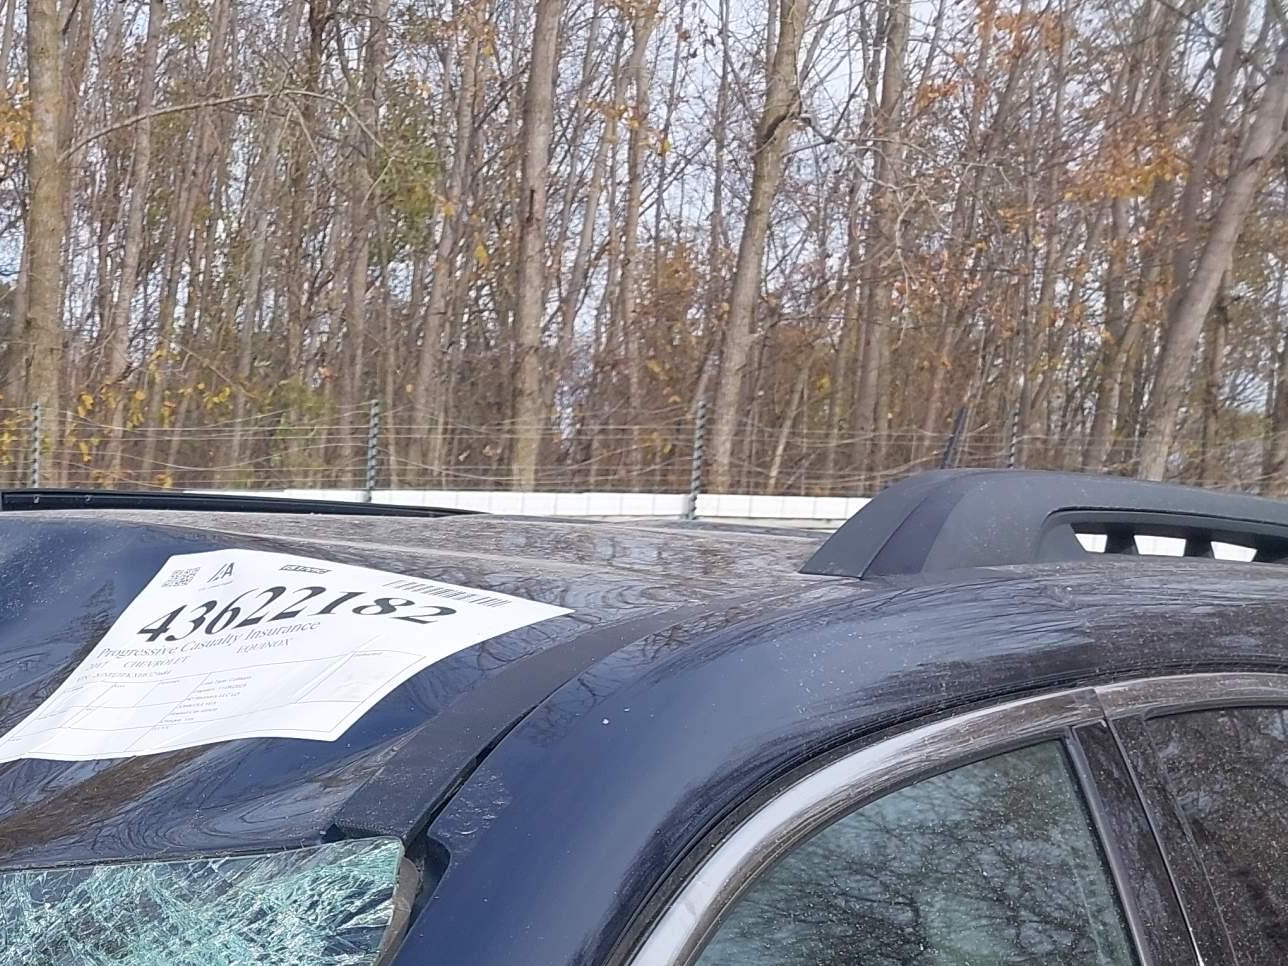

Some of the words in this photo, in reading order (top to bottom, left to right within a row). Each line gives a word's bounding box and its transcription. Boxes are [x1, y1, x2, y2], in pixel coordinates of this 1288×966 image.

[136, 586, 457, 642] 43622182
[96, 646, 180, 659] Progressive
[180, 633, 243, 652] Casualty
[244, 622, 321, 641] Insurance
